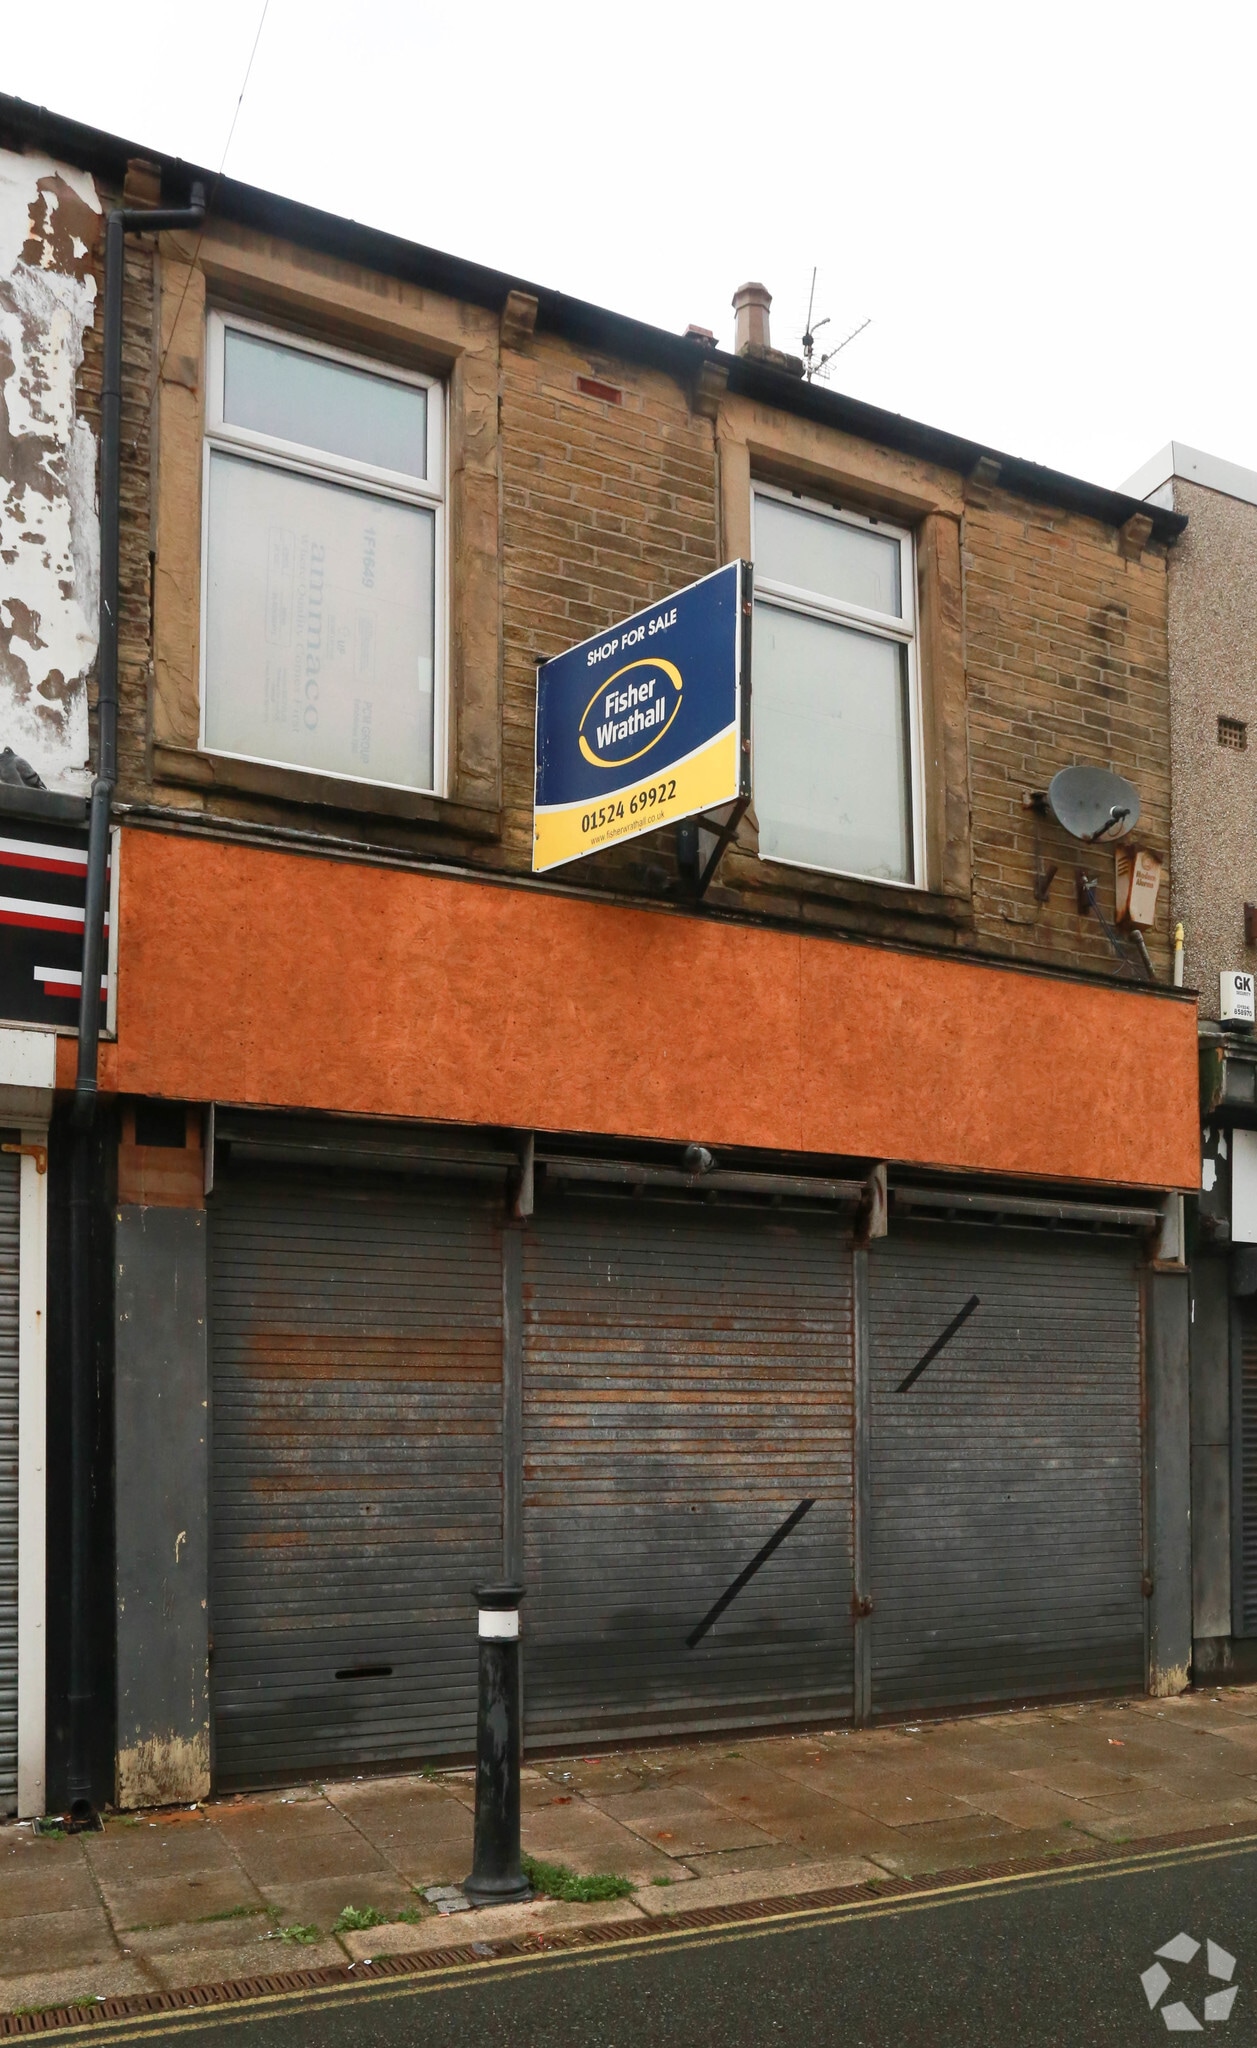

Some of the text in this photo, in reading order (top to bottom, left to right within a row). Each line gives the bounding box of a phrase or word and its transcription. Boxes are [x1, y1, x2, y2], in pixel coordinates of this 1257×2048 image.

[295, 583, 306, 637] Quality
[303, 542, 326, 731] ammaco
[587, 607, 677, 667] SHOP FOR SALE
[596, 696, 666, 749] Wrathall
[605, 678, 656, 719] Fisher
[581, 779, 676, 833] 01524 69922
[1234, 975, 1251, 992] GK
